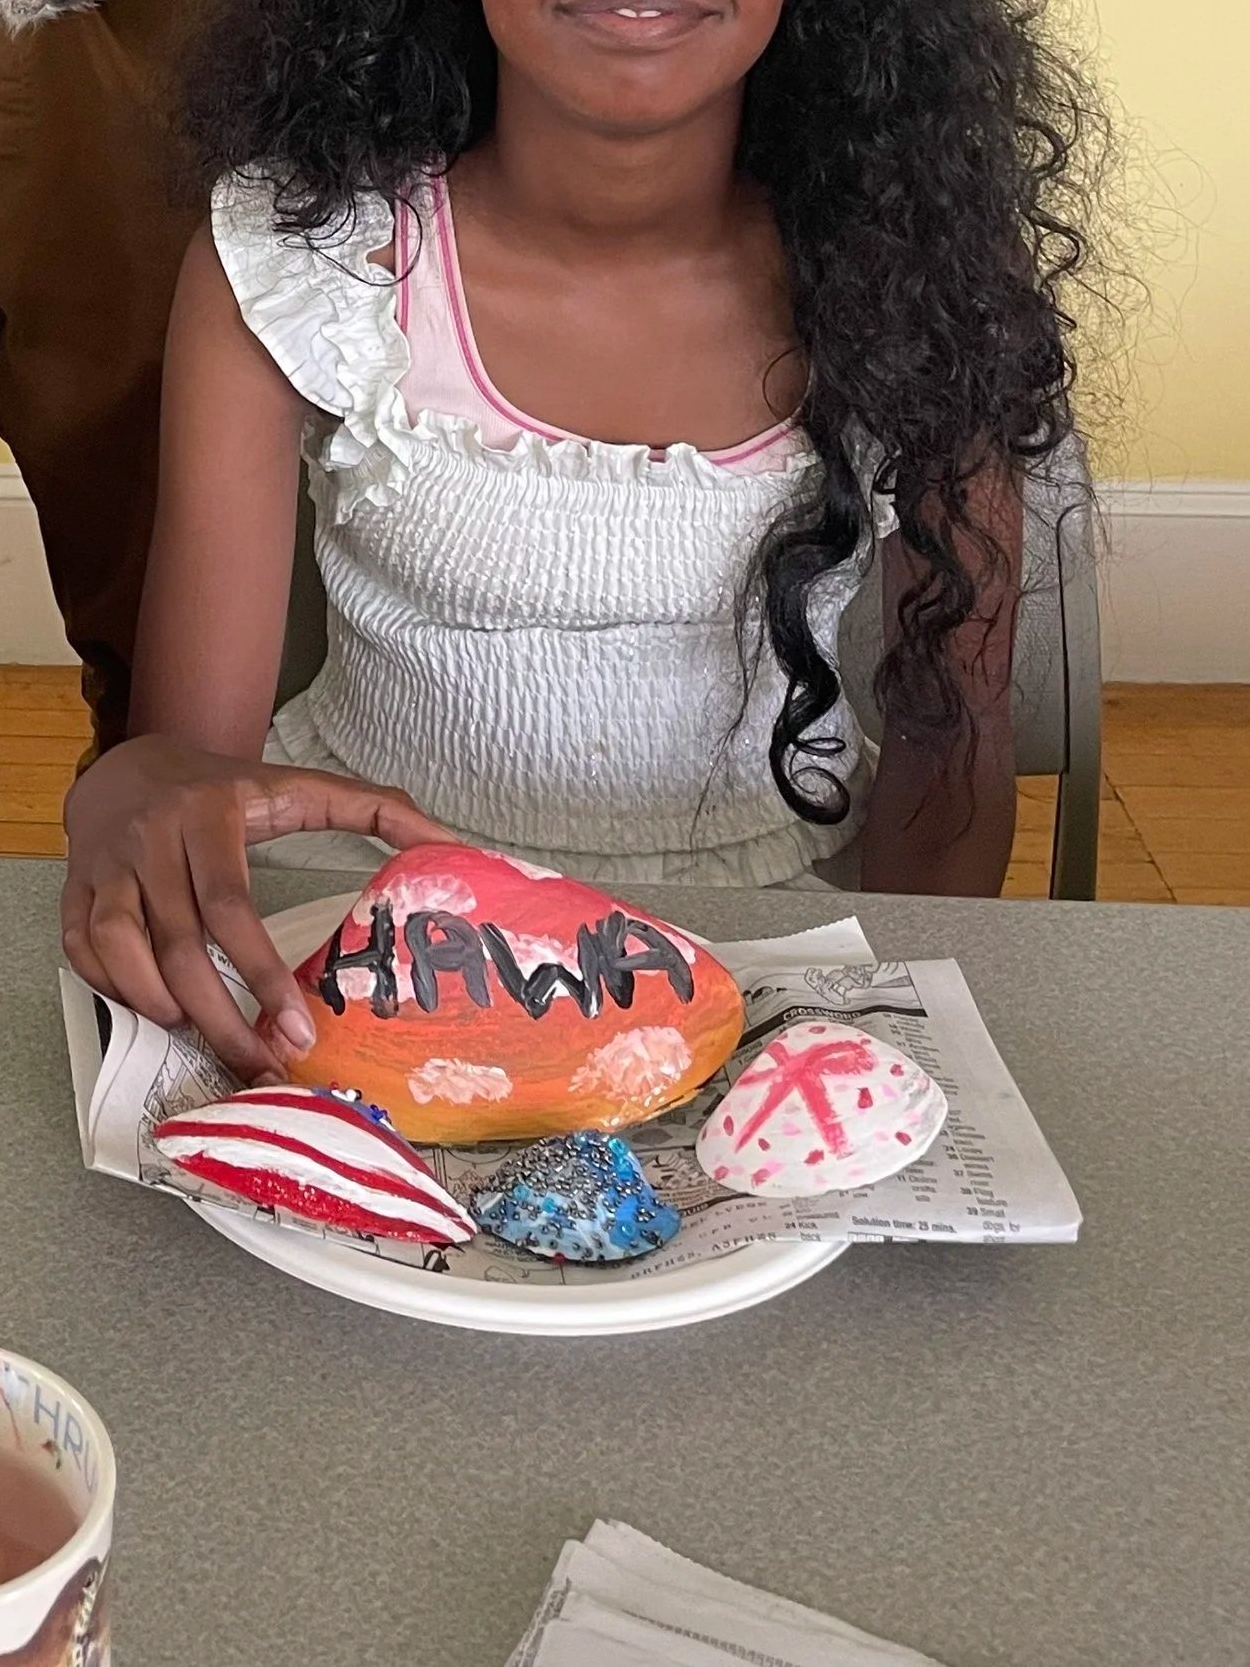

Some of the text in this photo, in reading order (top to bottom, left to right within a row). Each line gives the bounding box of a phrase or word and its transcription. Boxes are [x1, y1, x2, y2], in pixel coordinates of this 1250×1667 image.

[319, 900, 695, 1020] HAWA
[782, 1007, 861, 1022] CROSSWORD
[852, 1215, 891, 1229] Solution
